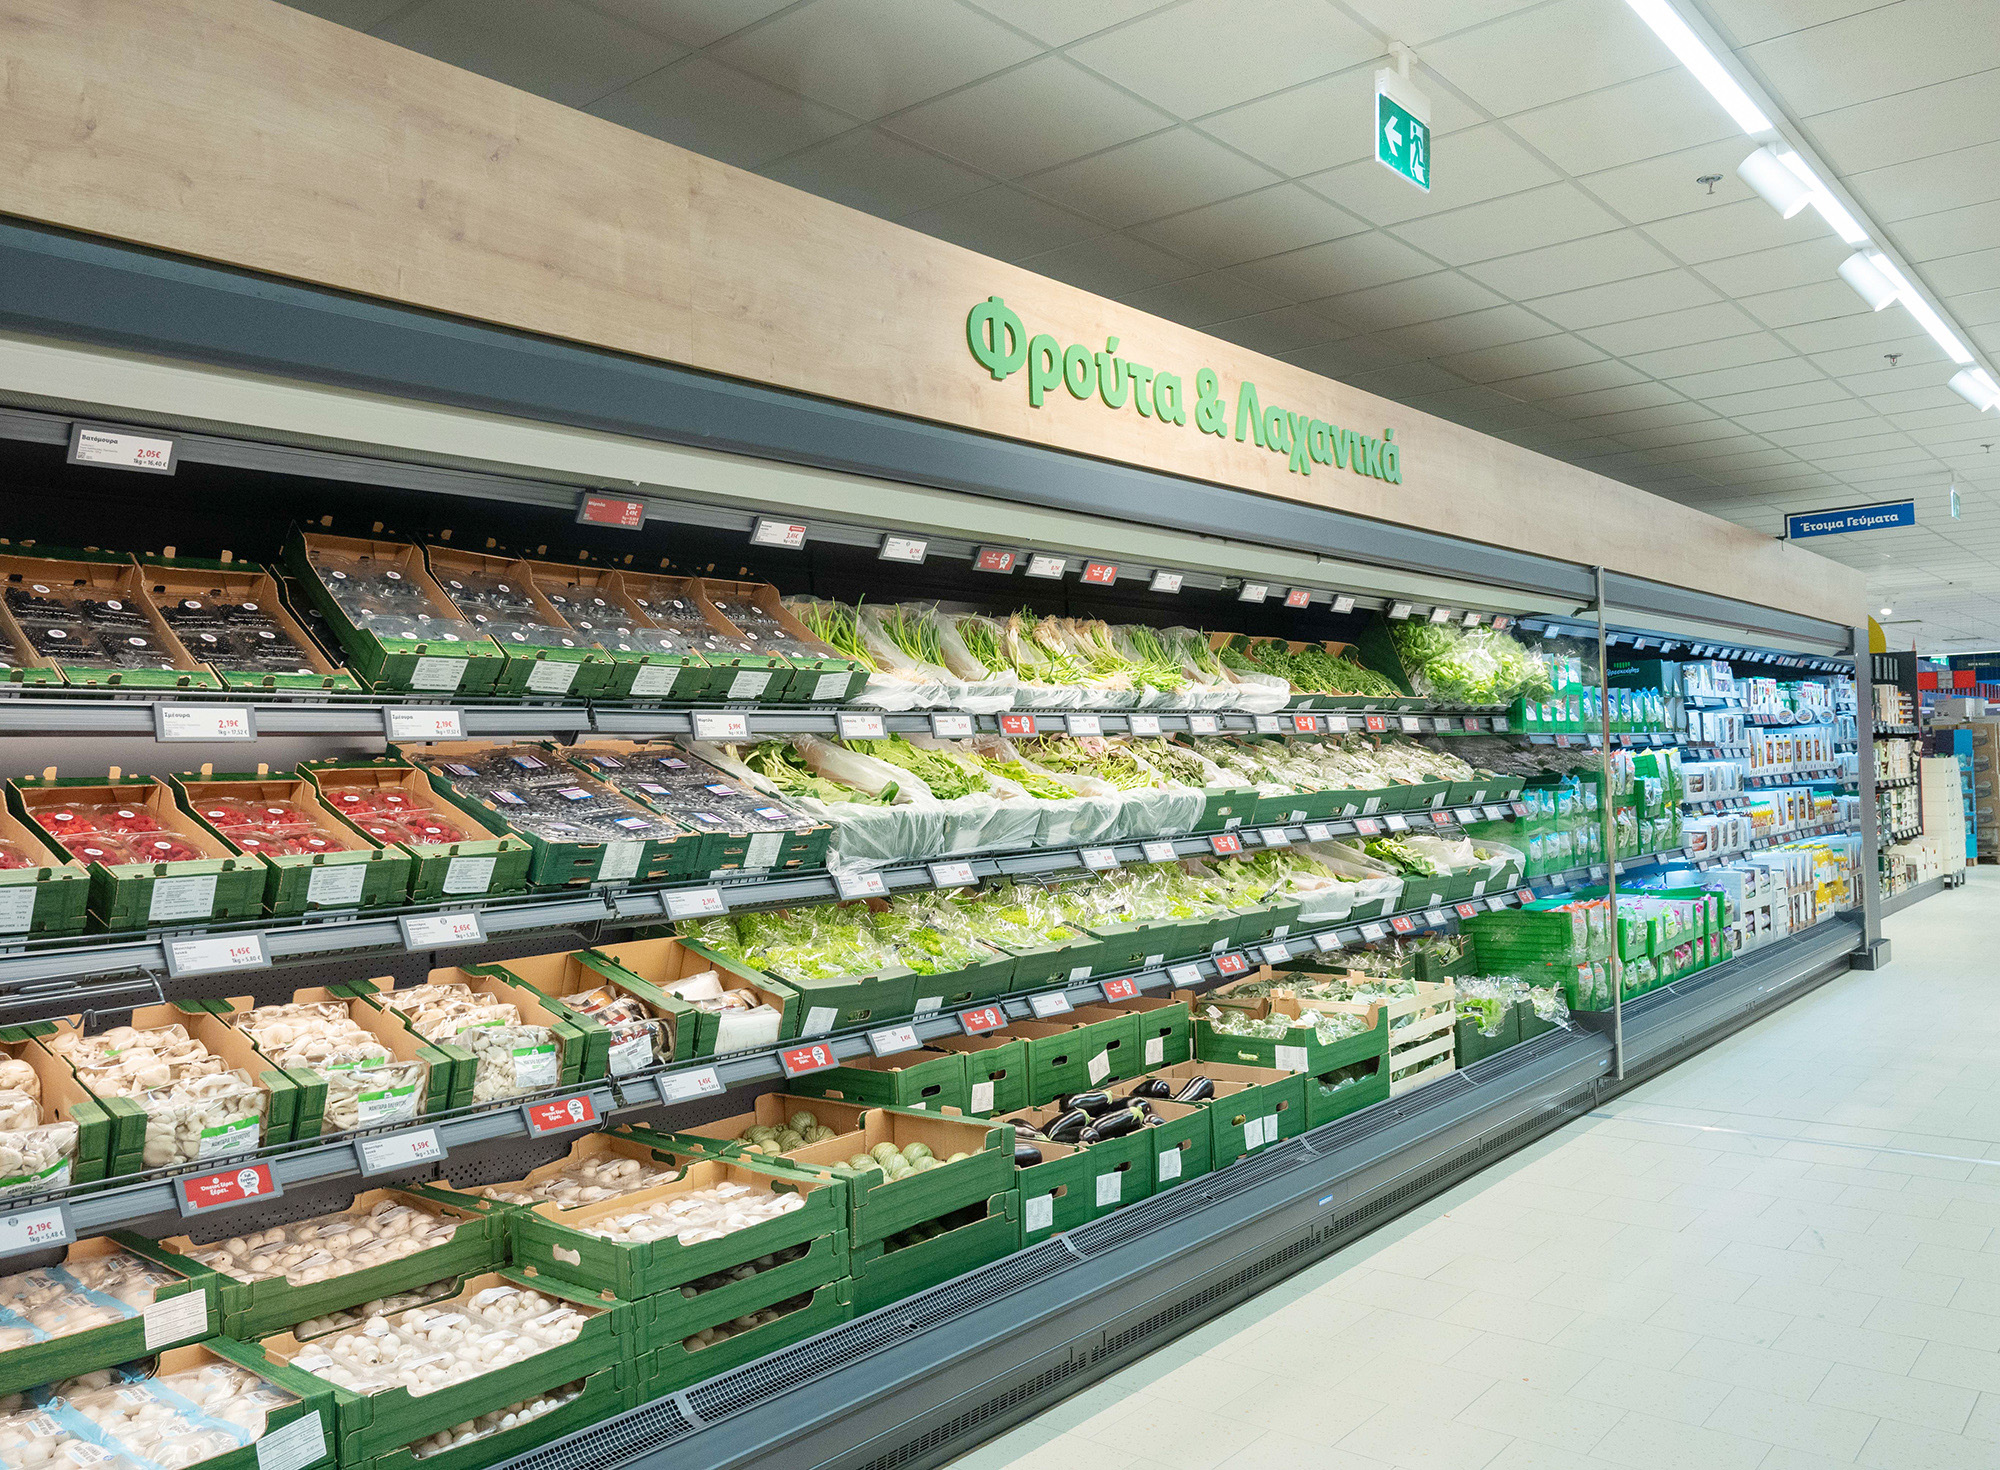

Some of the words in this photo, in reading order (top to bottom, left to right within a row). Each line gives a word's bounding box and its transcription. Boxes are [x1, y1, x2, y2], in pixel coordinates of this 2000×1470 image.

[966, 296, 1186, 426] Φρούτα
[1196, 368, 1228, 438] &
[1235, 381, 1402, 485] Λαχανικά
[82, 434, 118, 444] Βατόμουρα
[137, 449, 161, 458] 2,05€
[1800, 521, 1844, 532] Έτοιμα
[1847, 514, 1899, 528] Γεύματα
[218, 720, 238, 728] 2,19€
[229, 947, 250, 957] 1,45€
[27, 1222, 52, 1235] 2,19€
